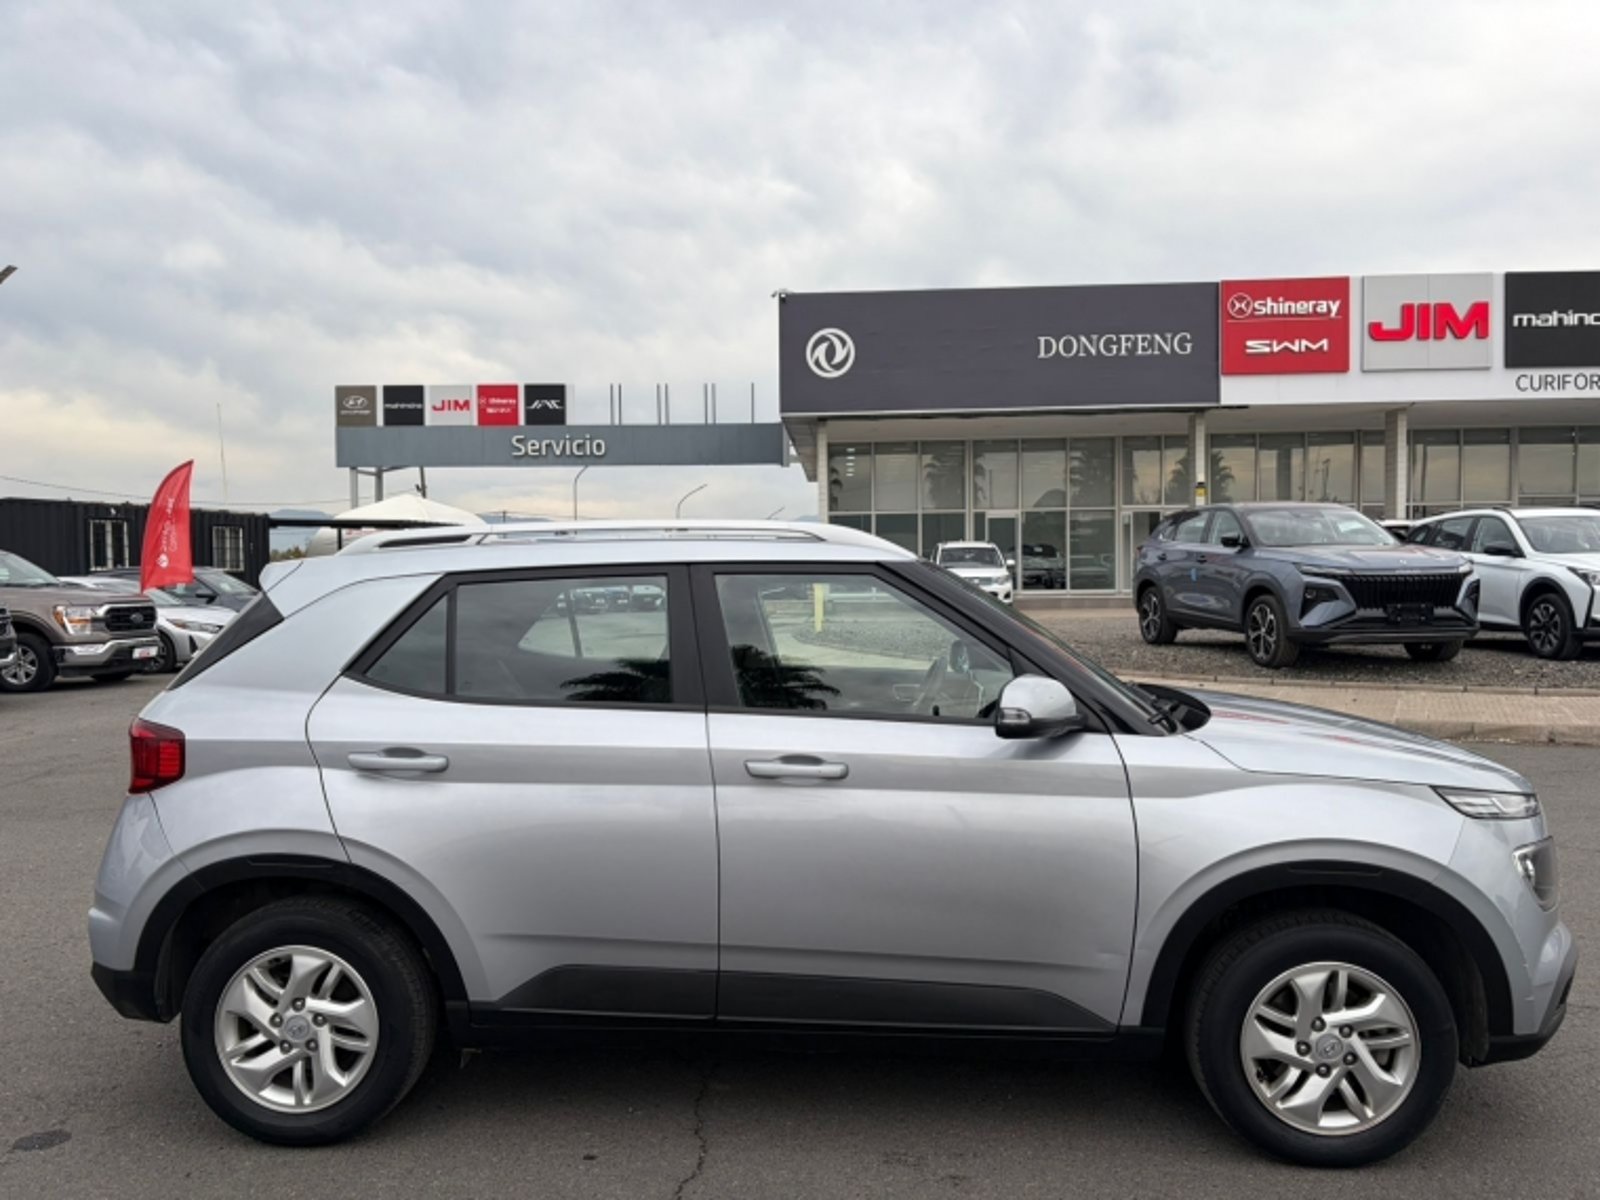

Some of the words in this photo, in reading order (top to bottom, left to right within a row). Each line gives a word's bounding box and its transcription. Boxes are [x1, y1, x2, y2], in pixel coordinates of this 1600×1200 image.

[1368, 301, 1489, 341] JIM
[1037, 332, 1193, 358] DONGFENG
[1245, 338, 1329, 353] SWM
[1515, 373, 1600, 391] CURIFOR
[432, 400, 470, 412] JIM
[511, 435, 606, 456] Servicio
